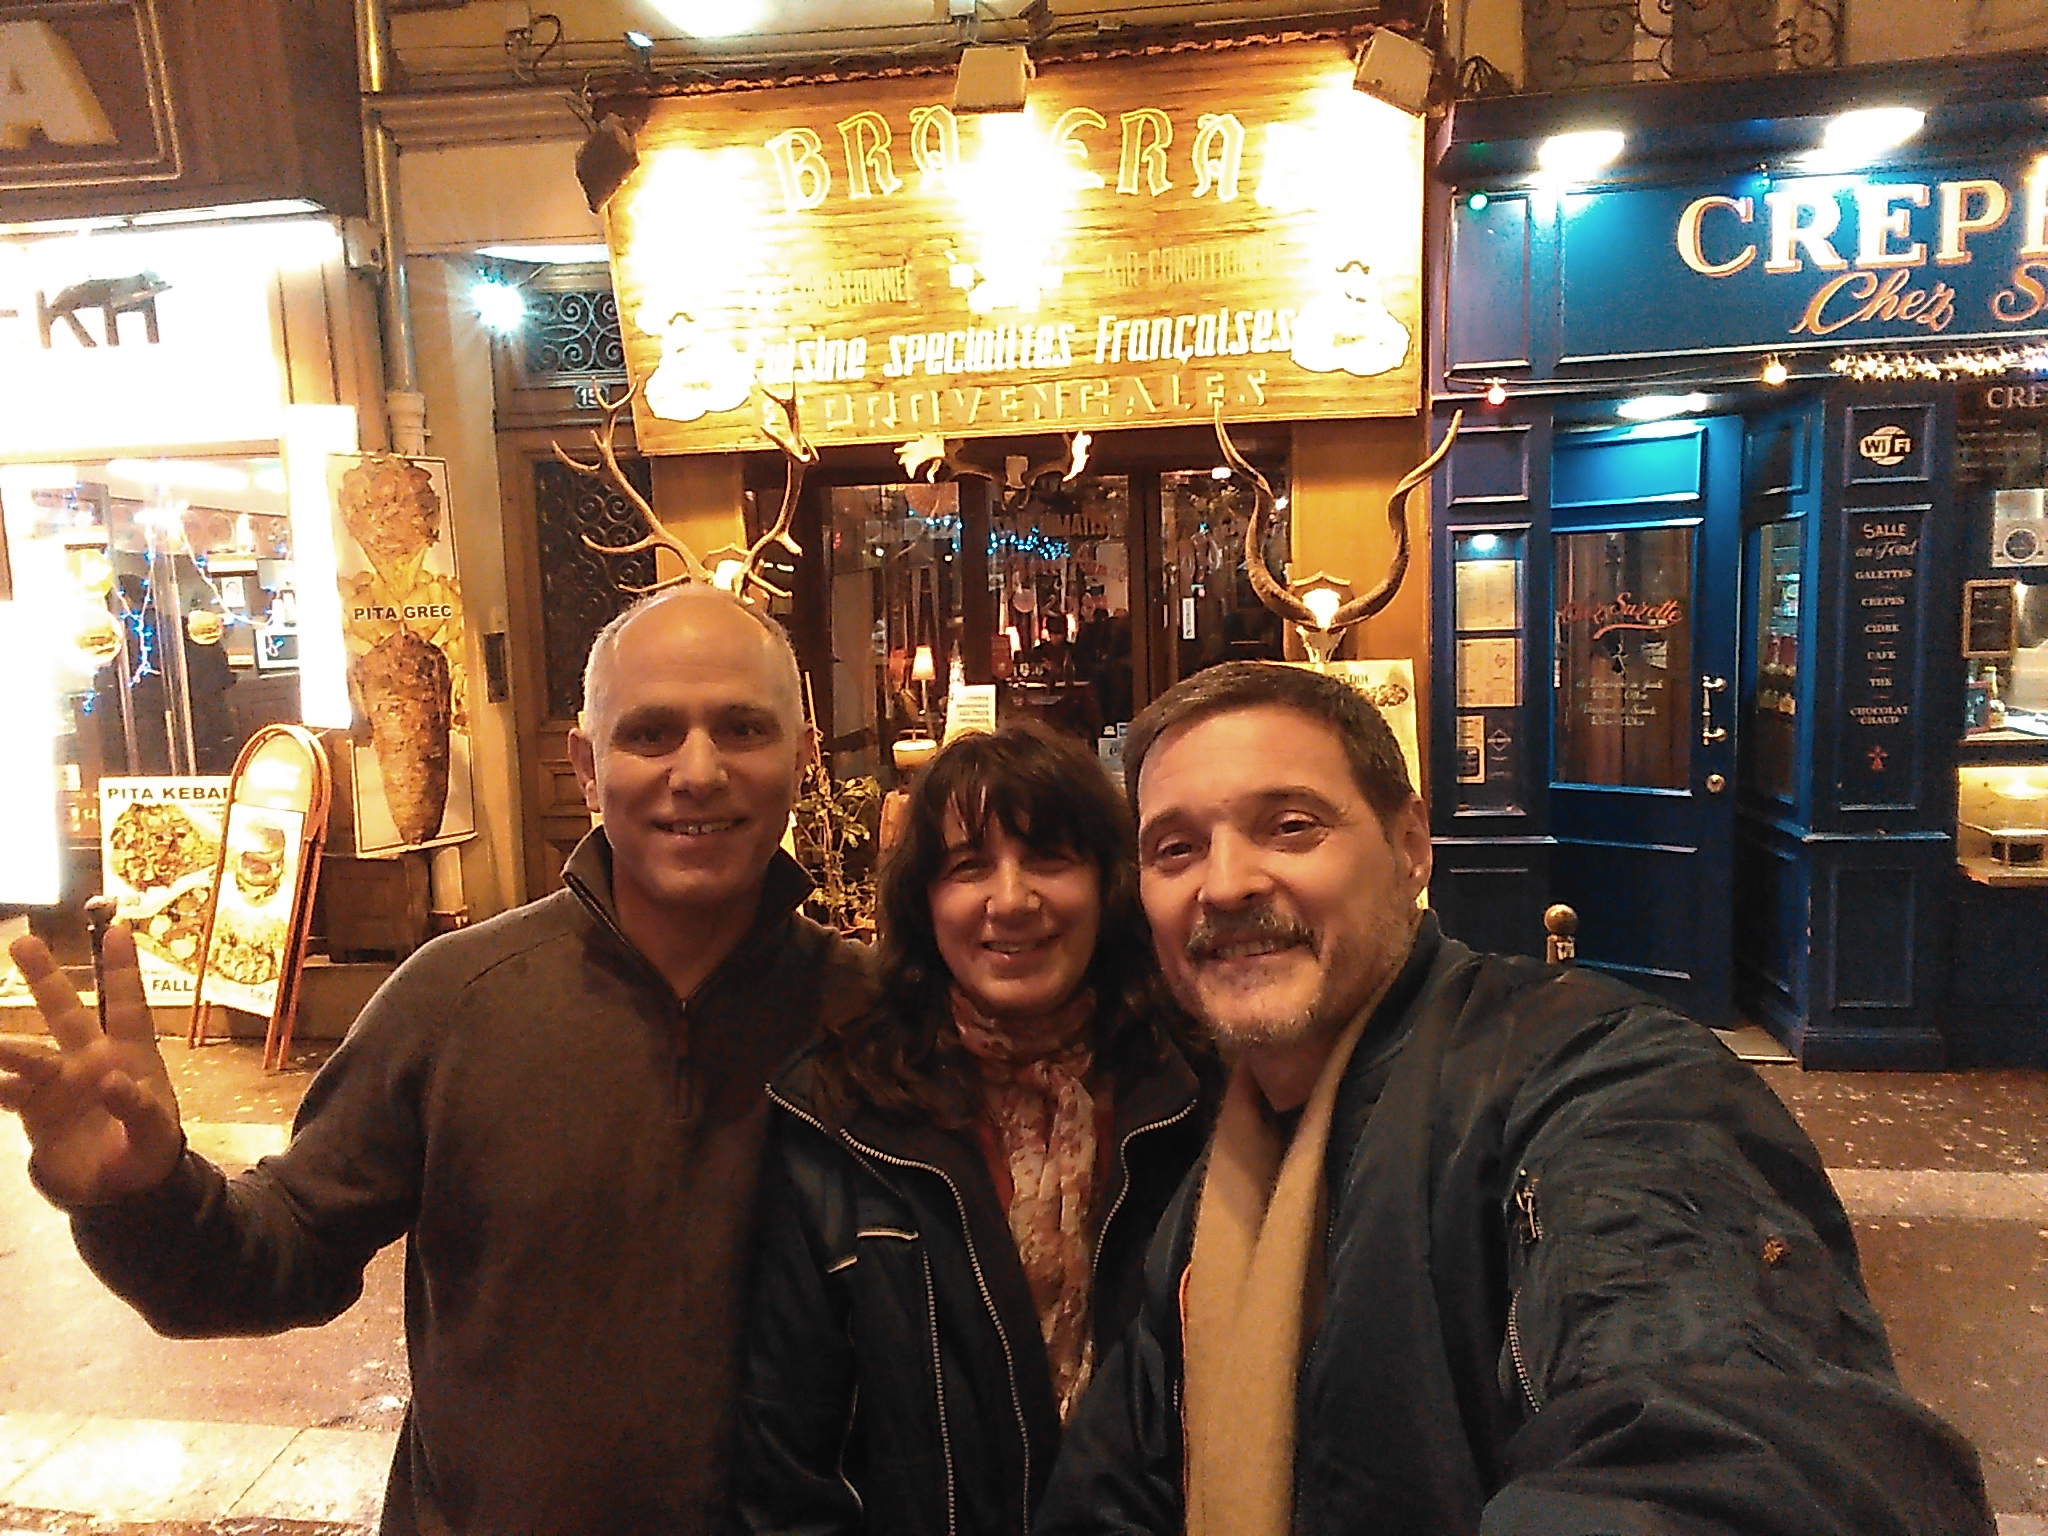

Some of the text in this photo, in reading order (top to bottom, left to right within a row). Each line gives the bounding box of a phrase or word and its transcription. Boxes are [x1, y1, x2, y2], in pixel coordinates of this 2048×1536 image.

[763, 104, 1247, 212] BRAERA
[1789, 268, 1956, 335] Chez
[1863, 523, 1907, 539] SALLE
[354, 605, 452, 620] PITA GREC
[107, 788, 153, 800] PITA
